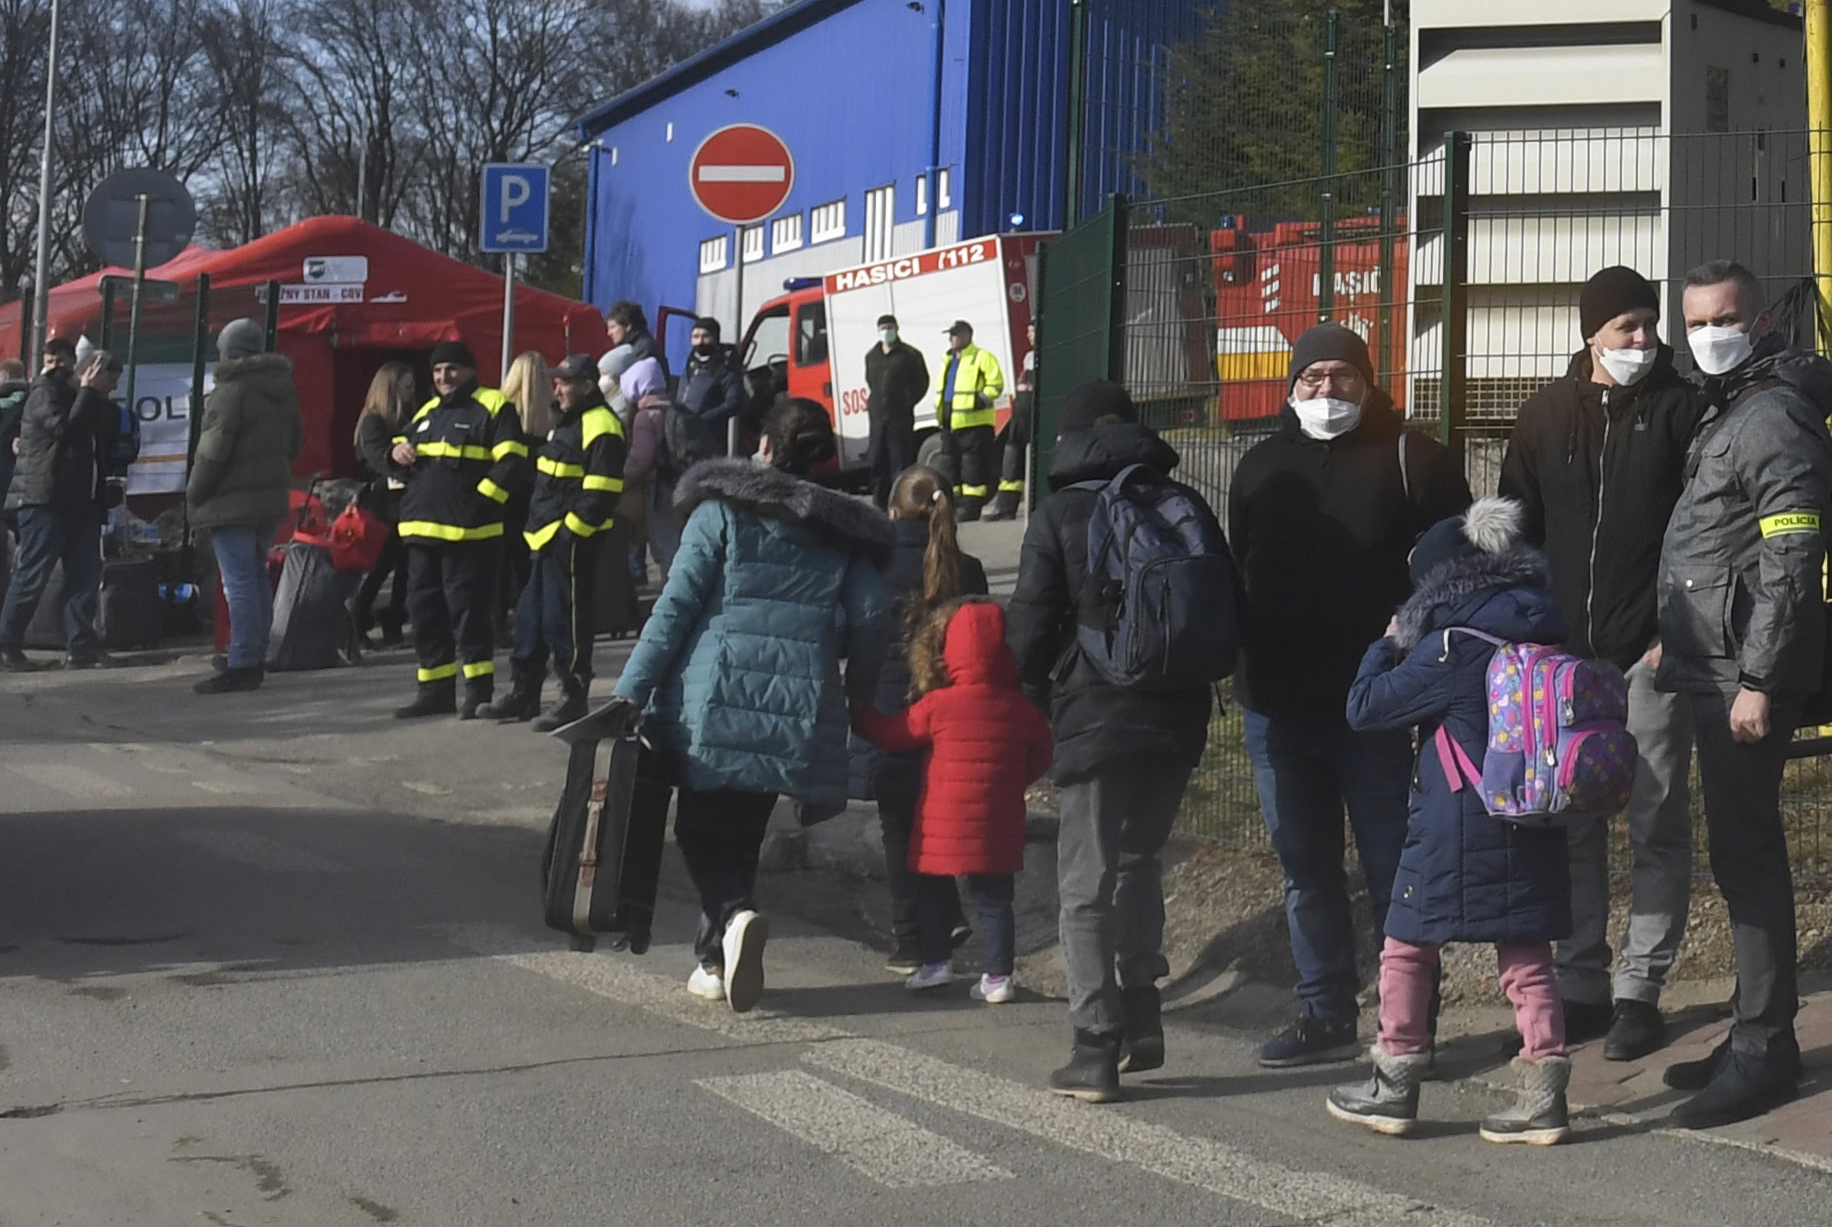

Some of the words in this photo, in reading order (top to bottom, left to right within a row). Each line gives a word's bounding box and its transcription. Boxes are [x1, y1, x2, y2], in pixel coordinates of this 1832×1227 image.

[500, 175, 531, 223] P
[946, 244, 985, 270] 112
[842, 387, 869, 416] SOS
